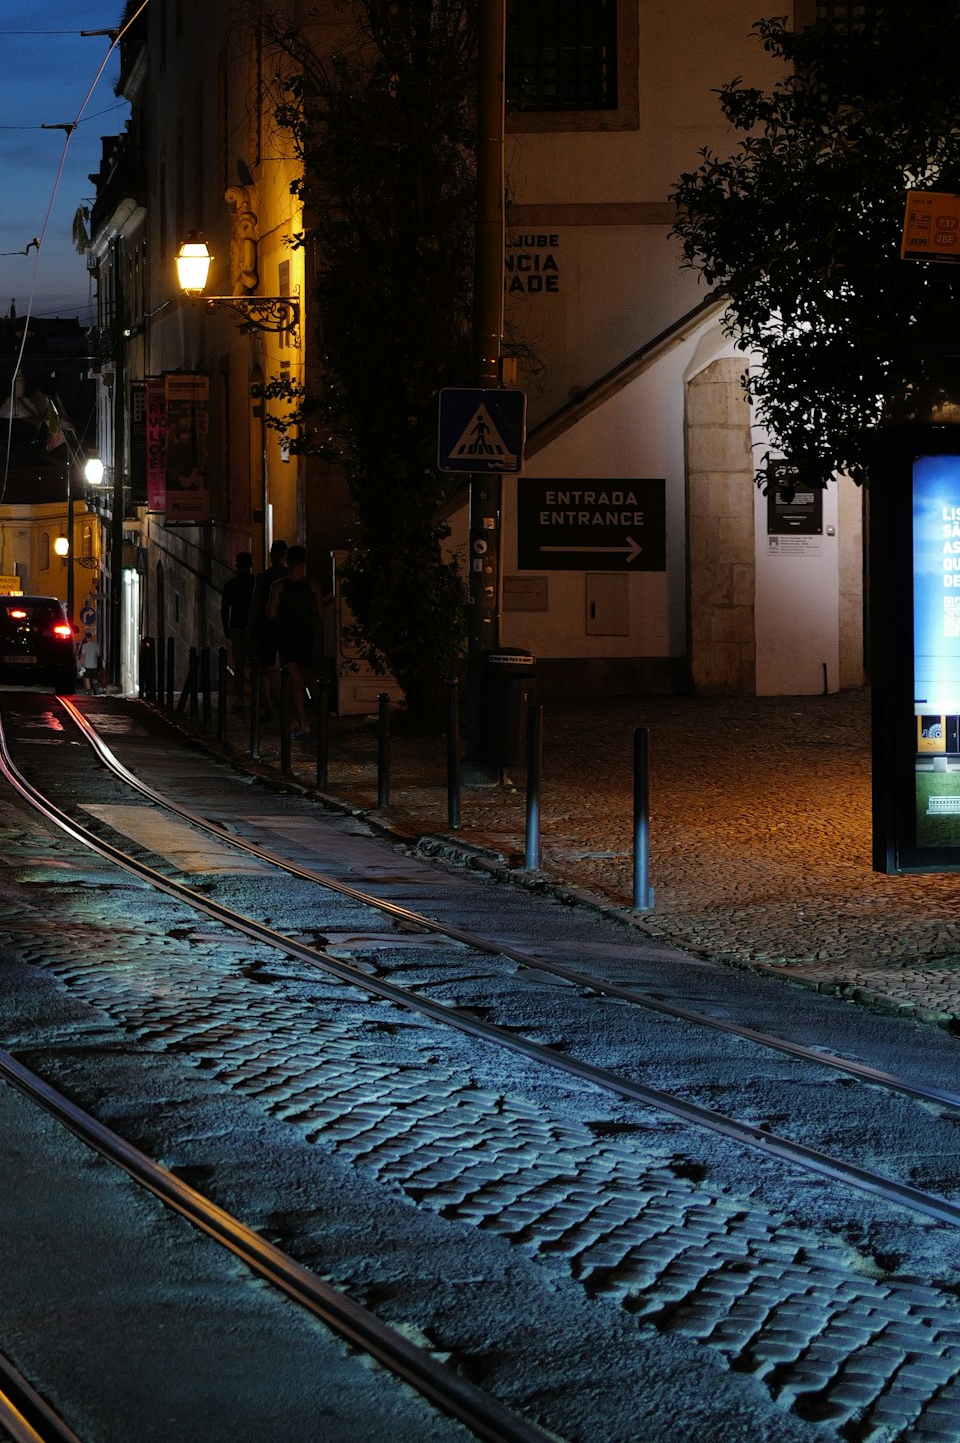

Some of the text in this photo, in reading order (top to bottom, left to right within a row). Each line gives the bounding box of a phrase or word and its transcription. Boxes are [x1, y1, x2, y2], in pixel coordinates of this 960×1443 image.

[939, 219, 956, 228] 737
[936, 234, 954, 244] 28E
[504, 275, 559, 293] ADE
[545, 491, 639, 505] ENTRADA
[539, 511, 645, 525] ENTRANCE
